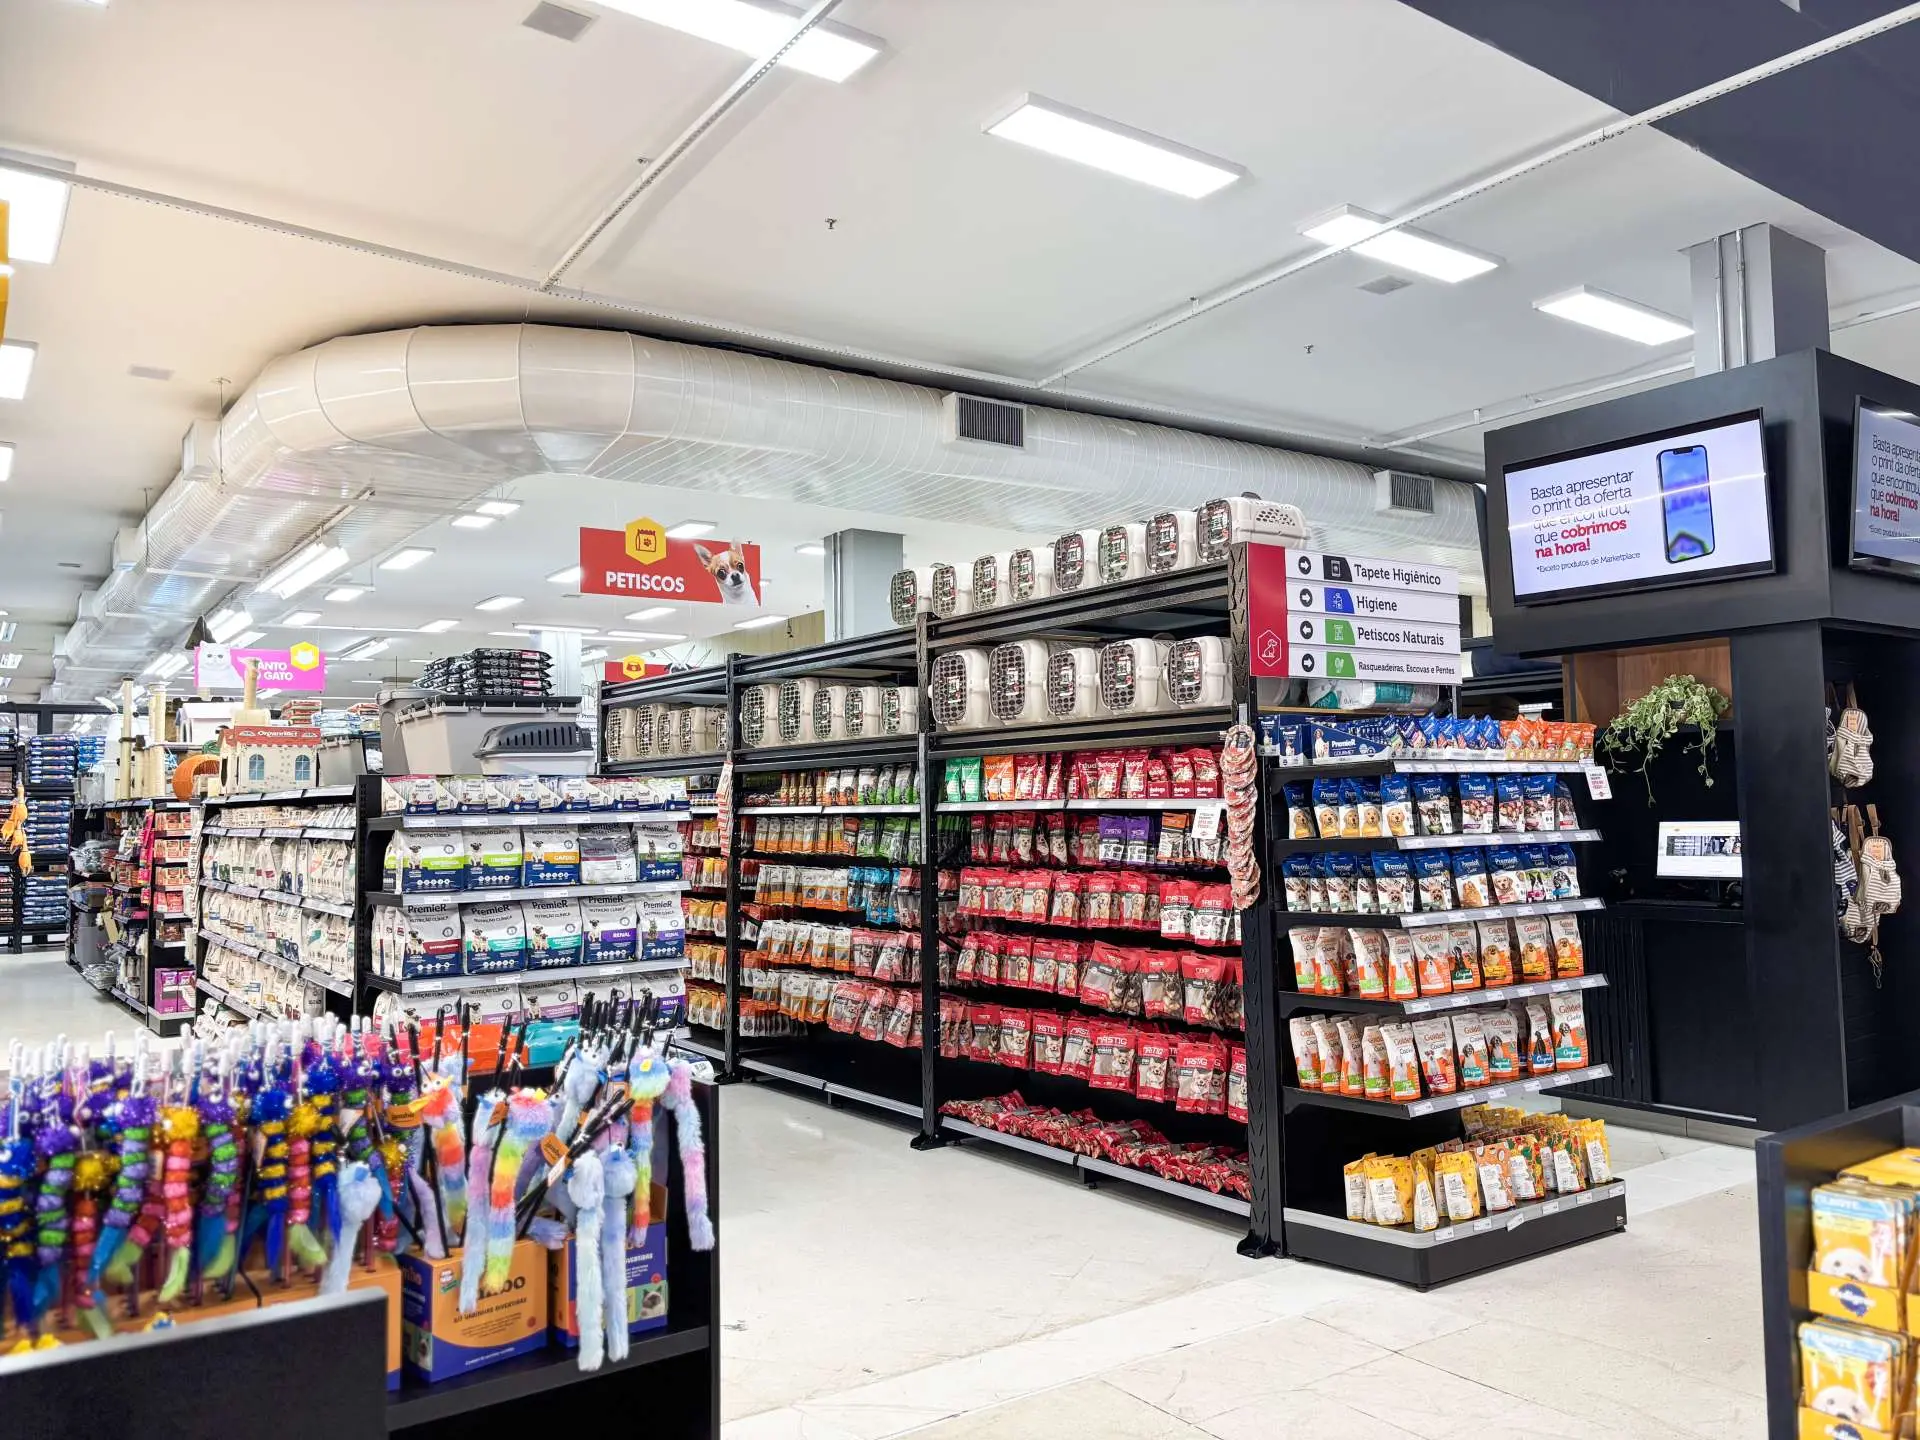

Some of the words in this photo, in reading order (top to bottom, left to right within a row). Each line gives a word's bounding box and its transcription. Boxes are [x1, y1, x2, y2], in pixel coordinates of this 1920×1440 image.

[1530, 484, 1563, 500] Basta
[1566, 471, 1634, 495] apresentar
[1871, 471, 1885, 487] que
[1532, 504, 1540, 514] o
[1543, 497, 1572, 516] print
[1574, 494, 1591, 507] da
[1594, 486, 1632, 504] oferta
[1871, 488, 1884, 503] que
[1886, 490, 1918, 510] cobrimos
[1870, 504, 1880, 518] na
[1880, 504, 1900, 522] hora!
[1534, 531, 1558, 546] que
[1560, 519, 1627, 540] cobrimos
[1535, 548, 1553, 558] na
[1554, 538, 1590, 556] hora!
[1600, 552, 1640, 564] Marketplace
[605, 571, 685, 592] PETISCOS
[1354, 564, 1390, 580] Tapete
[1392, 568, 1441, 586] Higiênico
[1356, 596, 1398, 613] Higiene
[1358, 627, 1400, 642] Petiscos
[1402, 629, 1444, 646] Naturais
[1358, 662, 1405, 674] Rasqueadeiras,
[1406, 665, 1430, 674] Escovas
[1436, 666, 1455, 675] Pentes
[264, 671, 294, 681] GATO
[1331, 739, 1356, 748] PremieR
[532, 900, 568, 910] PremieR
[588, 896, 624, 904] PremieR
[643, 900, 672, 908] PremieR
[408, 904, 447, 914] PremieR
[472, 904, 510, 916] PremieR
[1036, 1024, 1057, 1034] MASTIG
[1096, 1036, 1127, 1046] MASTIG
[1184, 1058, 1208, 1066] MASTIG
